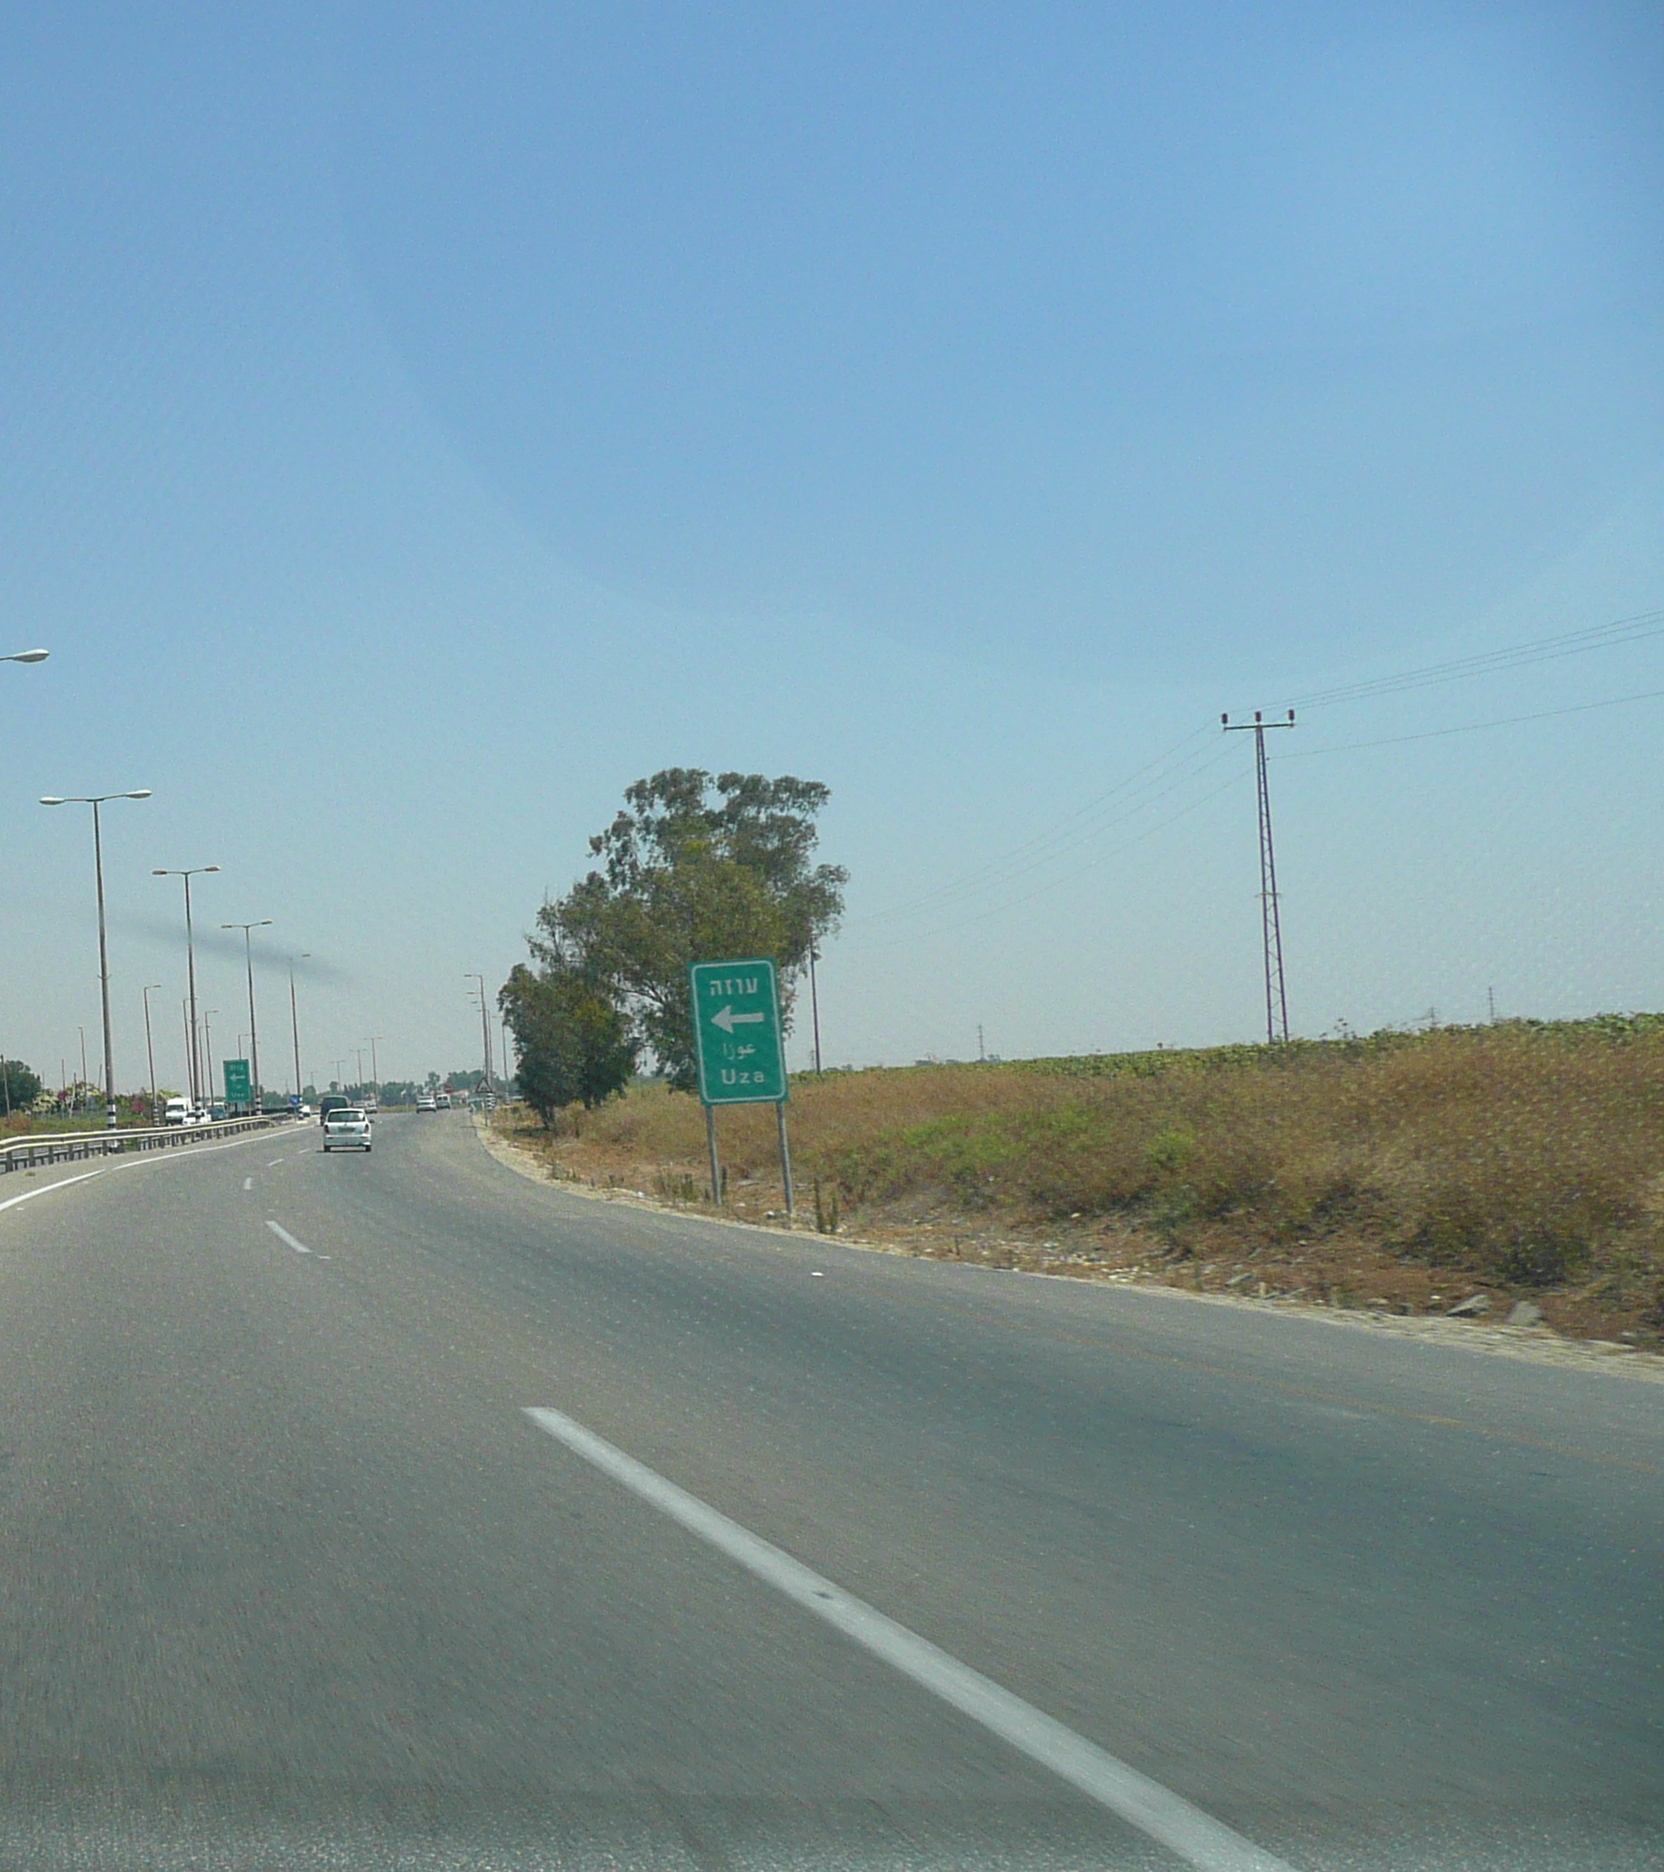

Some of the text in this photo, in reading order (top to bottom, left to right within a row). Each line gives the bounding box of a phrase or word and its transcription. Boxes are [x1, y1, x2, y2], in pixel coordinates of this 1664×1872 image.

[710, 977, 758, 996] עוזה
[722, 1042, 756, 1060] عوزا
[721, 1068, 765, 1085] Uza
